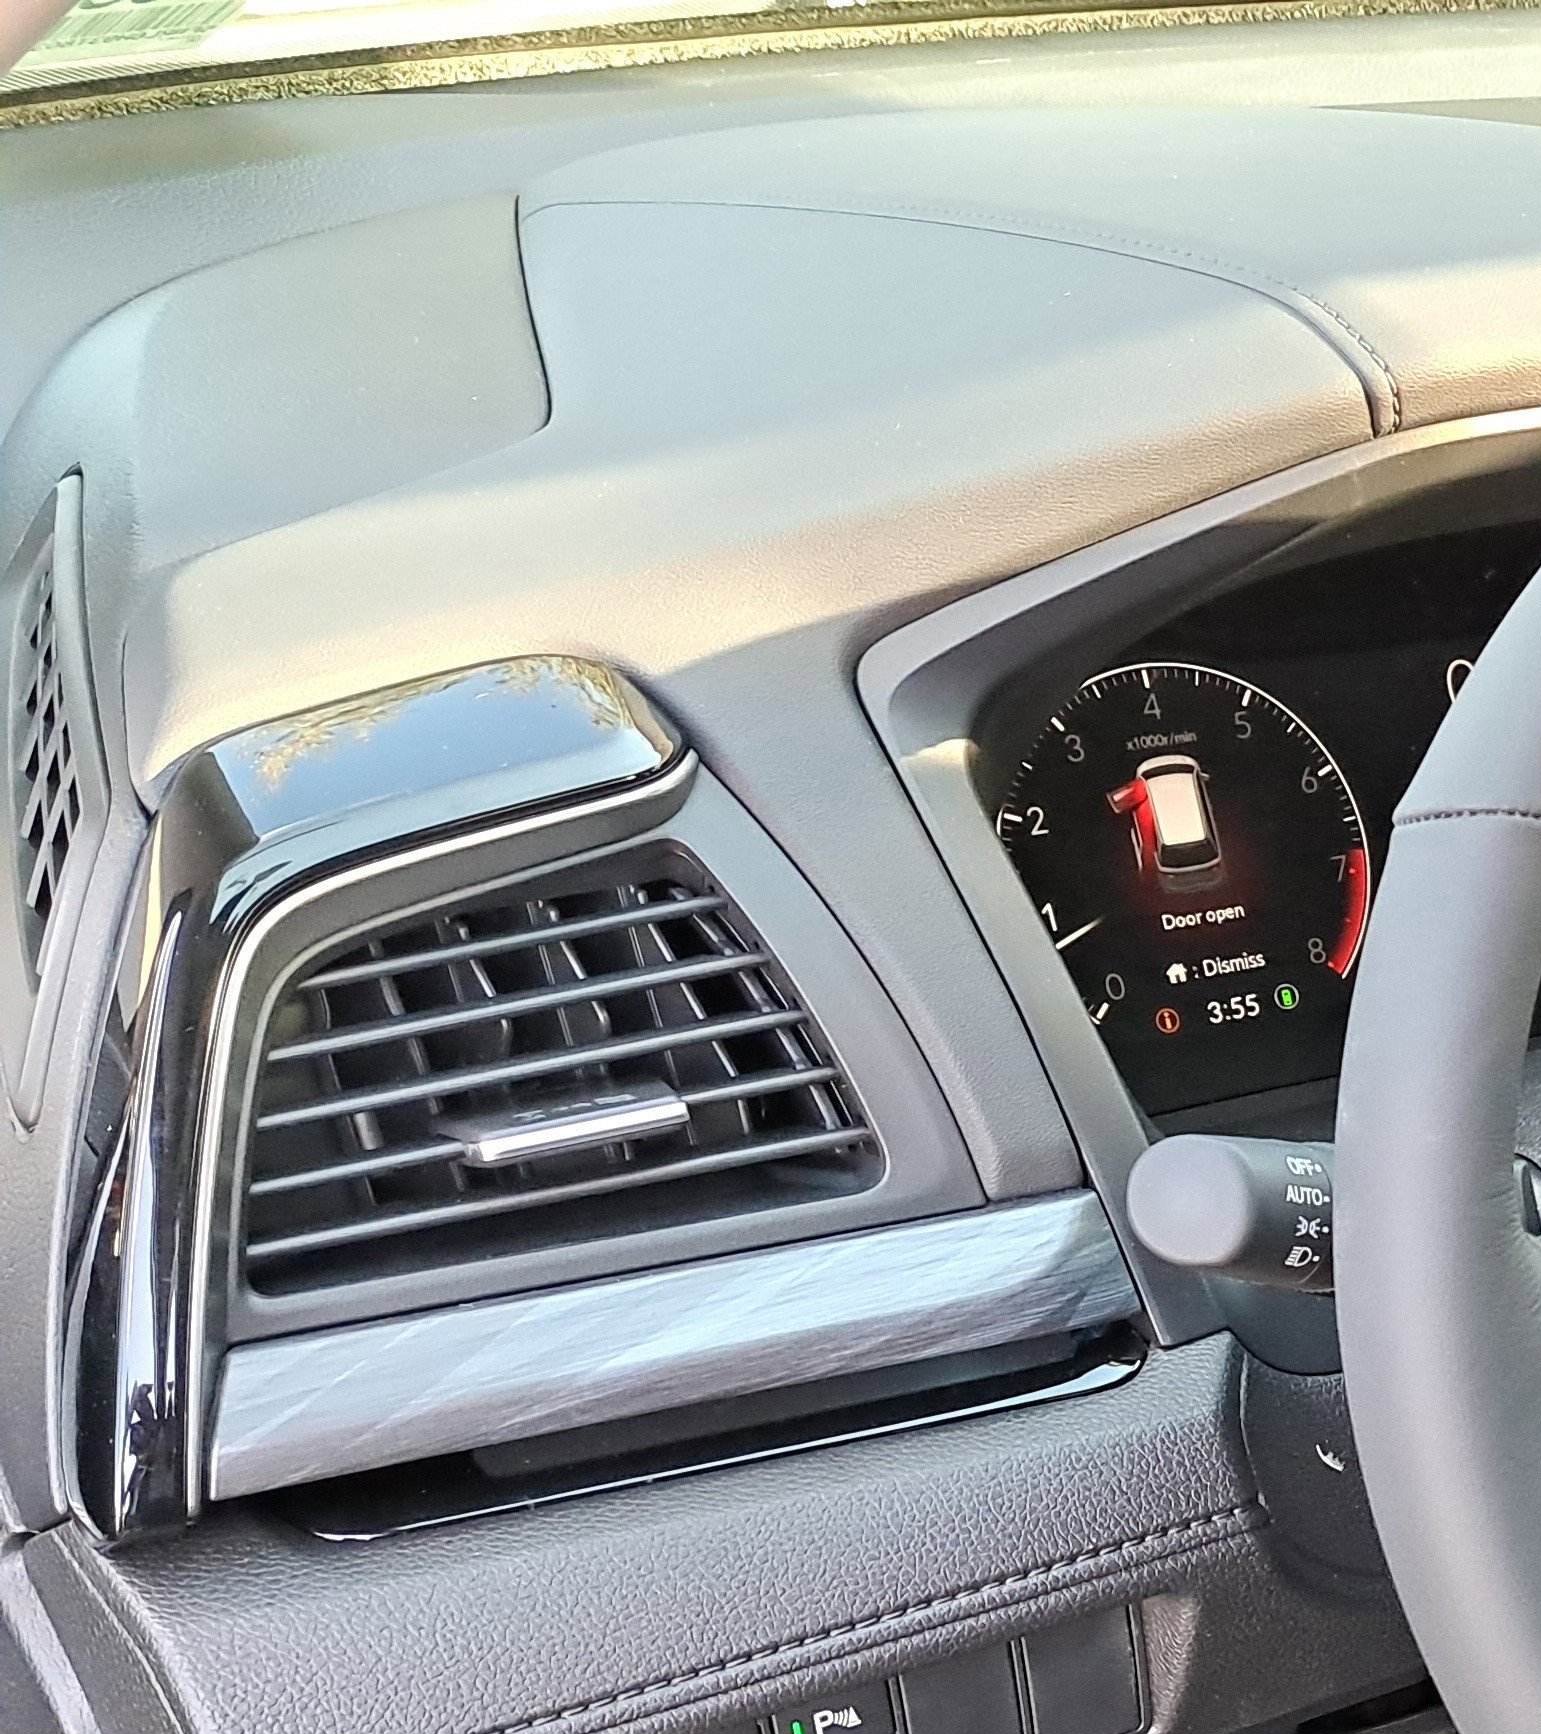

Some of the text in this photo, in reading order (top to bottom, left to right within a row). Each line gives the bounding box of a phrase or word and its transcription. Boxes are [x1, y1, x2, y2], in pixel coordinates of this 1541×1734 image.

[1143, 694, 1161, 720] 4
[1234, 712, 1252, 739] 5
[1066, 735, 1085, 762] 3
[1126, 729, 1197, 751] x1000r/min
[1302, 767, 1318, 793] 6
[1027, 807, 1049, 835] 2
[1330, 855, 1346, 881] 7
[1042, 904, 1059, 931] 1
[1161, 904, 1245, 931] Door open
[1308, 938, 1326, 963] 8
[1202, 952, 1265, 977] Dismiss
[1106, 974, 1125, 999] 0
[1207, 994, 1260, 1024] 3:55
[1286, 1156, 1314, 1176] OFF
[1286, 1185, 1322, 1206] AUTO
